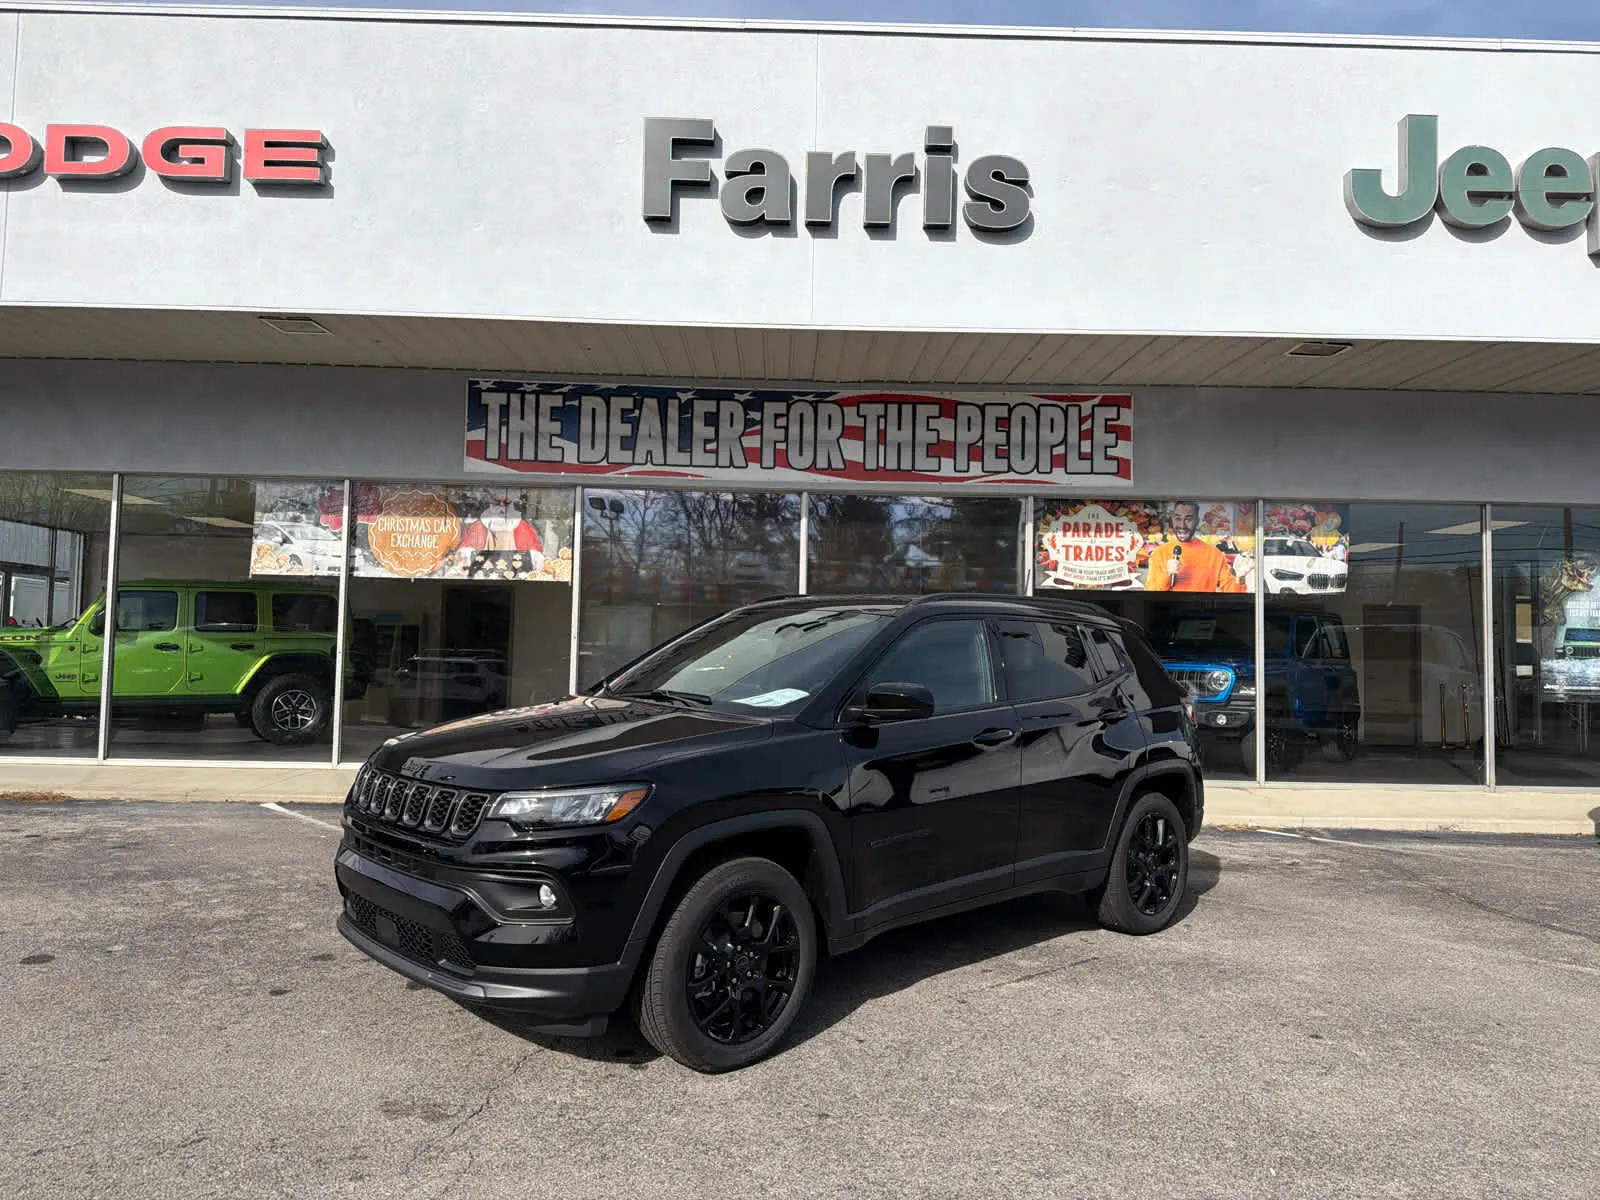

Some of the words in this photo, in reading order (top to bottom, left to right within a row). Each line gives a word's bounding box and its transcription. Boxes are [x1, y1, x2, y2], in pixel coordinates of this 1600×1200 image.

[643, 116, 1031, 231] Farris
[1343, 113, 1600, 253] Jee
[481, 390, 566, 464] THE
[577, 393, 749, 469] DEALER
[760, 398, 846, 471] FOR
[857, 402, 942, 473] THE
[954, 402, 1121, 475] PEOPLE
[377, 517, 431, 533] CHRISTMAS
[434, 517, 451, 533] CAR
[1062, 521, 1125, 538] PARADE
[390, 533, 439, 549] EXCHANGE
[1062, 545, 1125, 562] TRADES
[55, 672, 77, 680] Jeep
